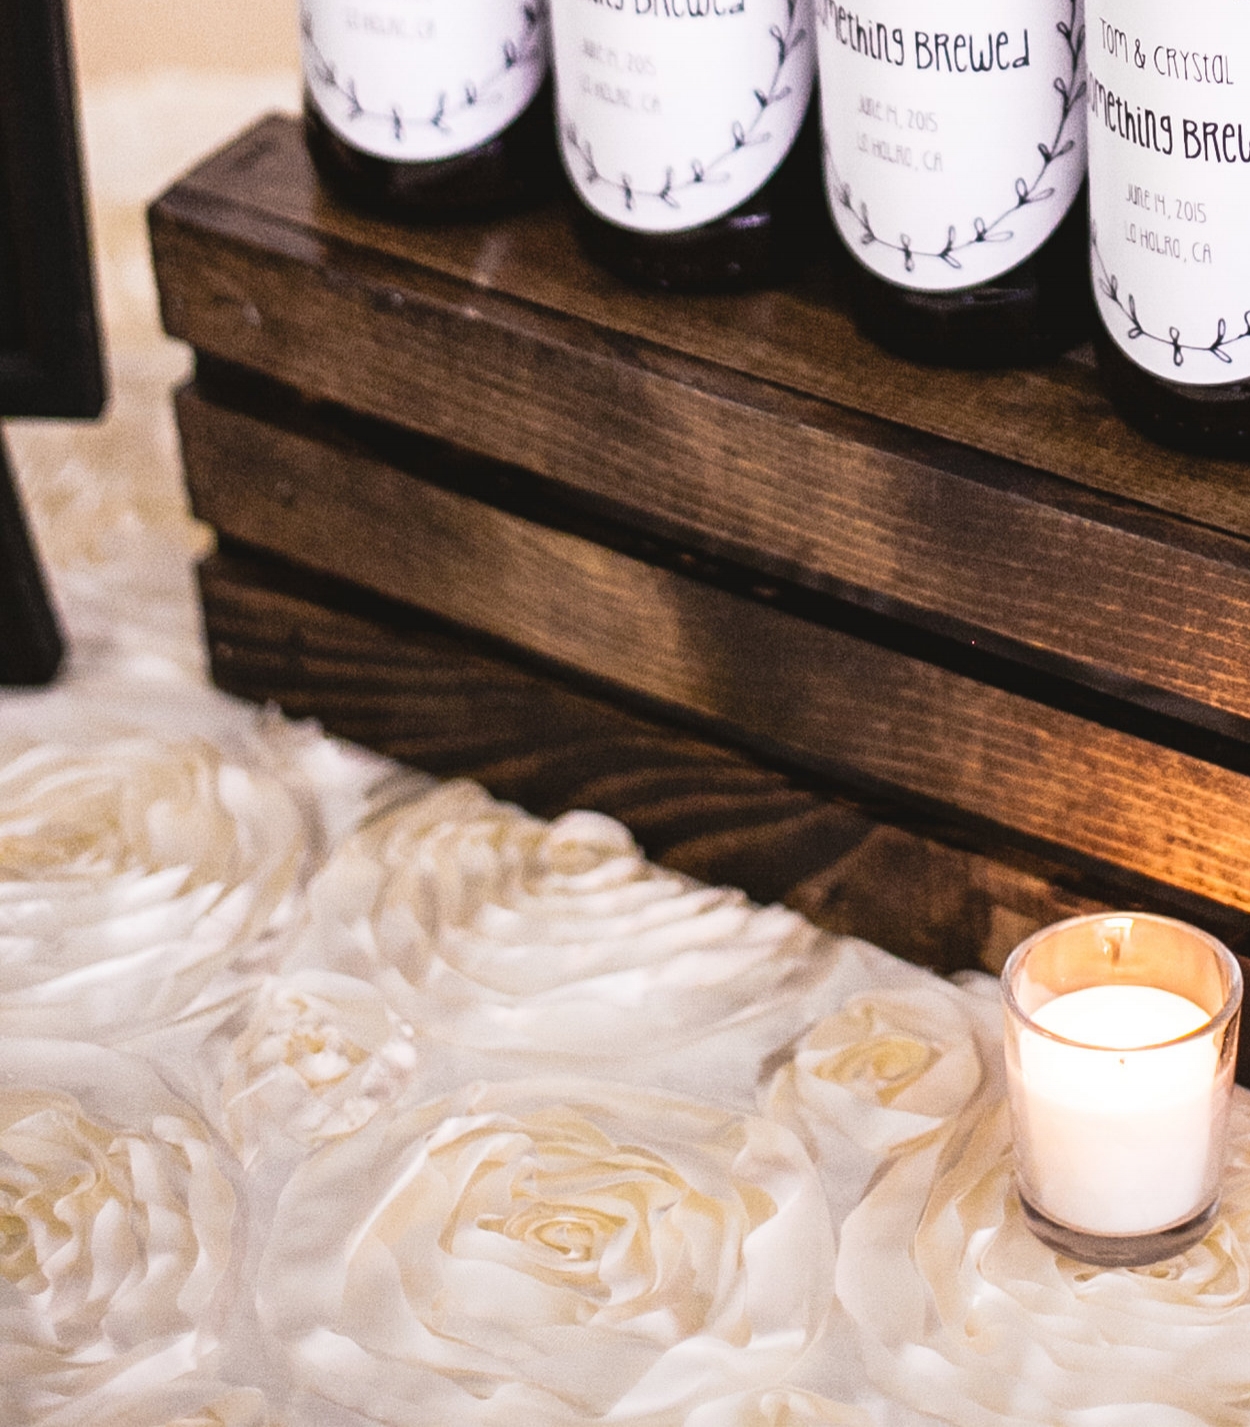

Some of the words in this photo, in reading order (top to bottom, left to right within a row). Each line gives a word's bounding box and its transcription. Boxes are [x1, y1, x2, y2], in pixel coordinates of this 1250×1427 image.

[1134, 38, 1146, 69] &
[1176, 198, 1207, 223] 2015
[1192, 241, 1212, 264] CA
